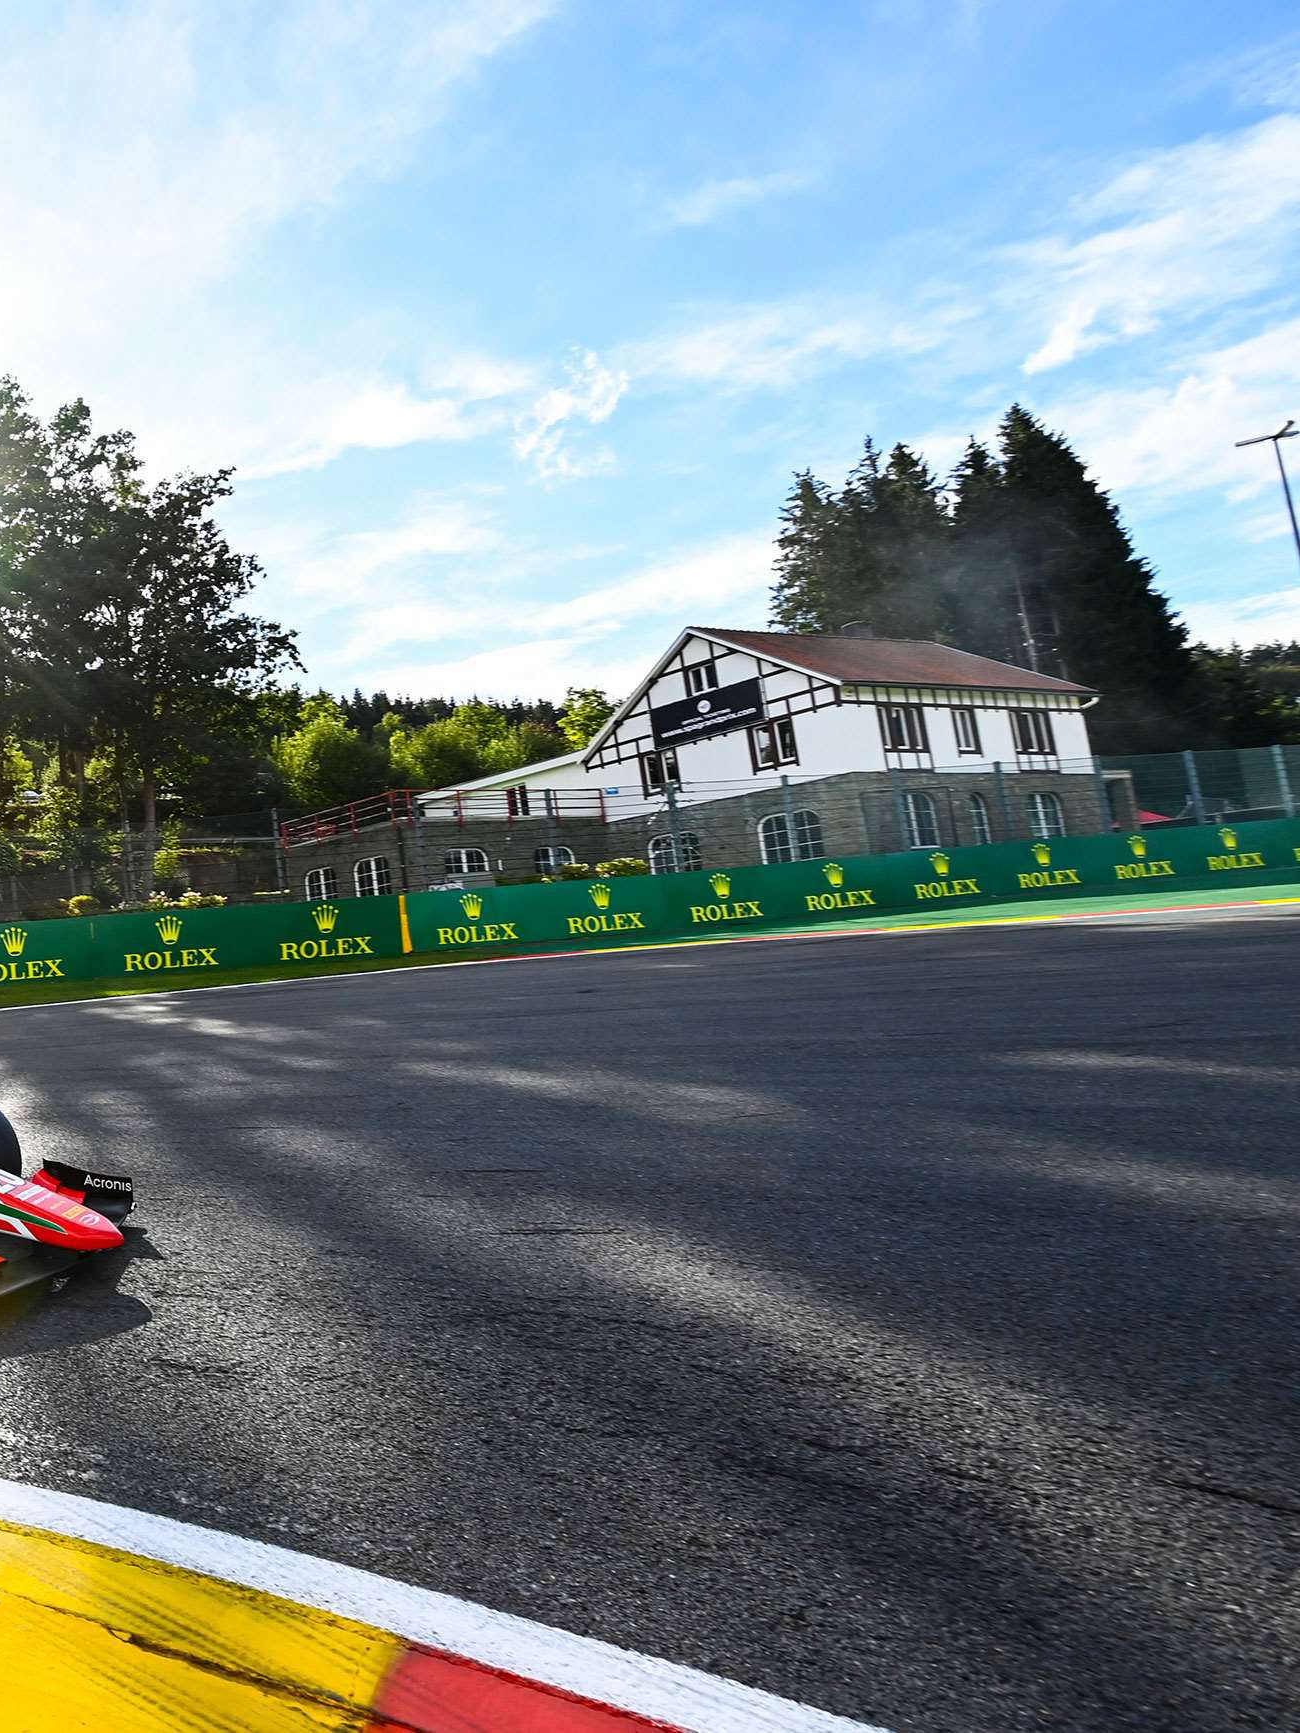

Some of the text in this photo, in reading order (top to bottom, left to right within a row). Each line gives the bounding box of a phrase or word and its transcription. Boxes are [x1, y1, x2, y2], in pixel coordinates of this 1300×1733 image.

[1115, 861, 1174, 878] ROLEX
[1206, 853, 1266, 870] ROLEX
[1018, 869, 1082, 887] ROLEX
[915, 879, 981, 898] ROLEX
[806, 890, 877, 910] ROLEX
[690, 901, 765, 922] ROLEX
[567, 912, 646, 933] ROLEX
[437, 923, 520, 944] ROLEX
[279, 936, 374, 960] ROLEX
[123, 947, 219, 971] ROLEX
[83, 1174, 132, 1191] Acronis
